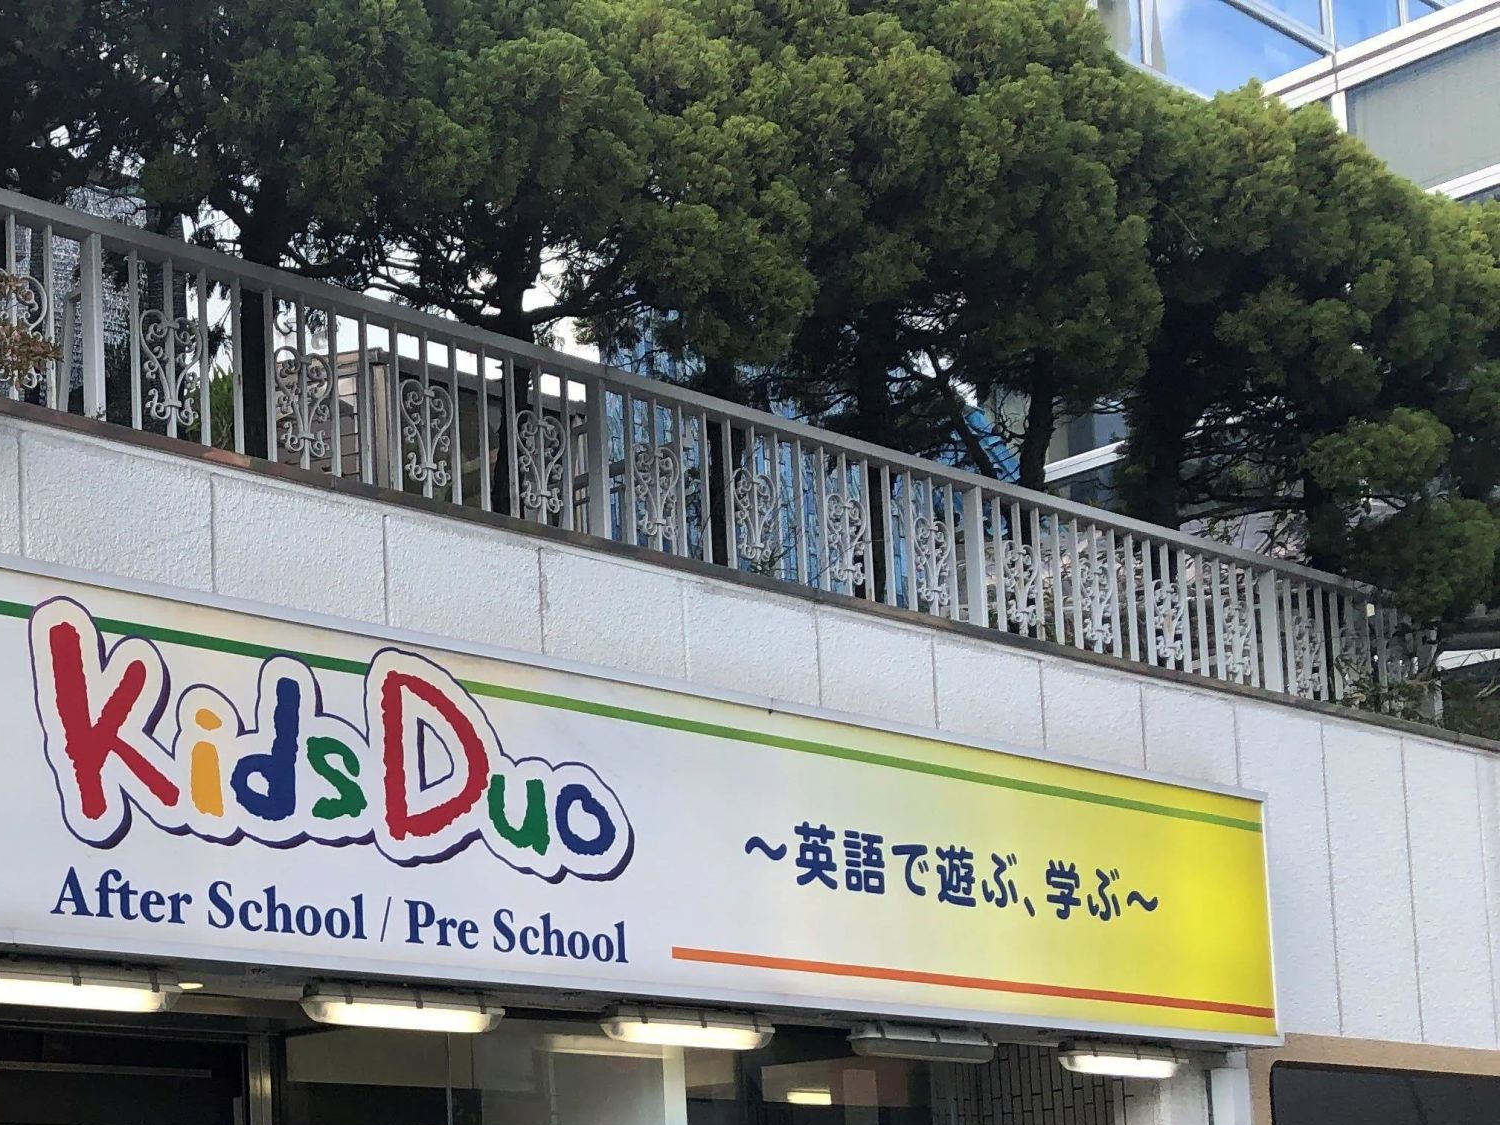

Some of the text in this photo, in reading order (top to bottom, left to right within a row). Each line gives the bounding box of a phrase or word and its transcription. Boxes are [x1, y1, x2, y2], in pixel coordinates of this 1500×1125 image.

[50, 865, 193, 925] After
[207, 880, 368, 941] School
[404, 899, 479, 949] Pre
[492, 908, 629, 965] School
